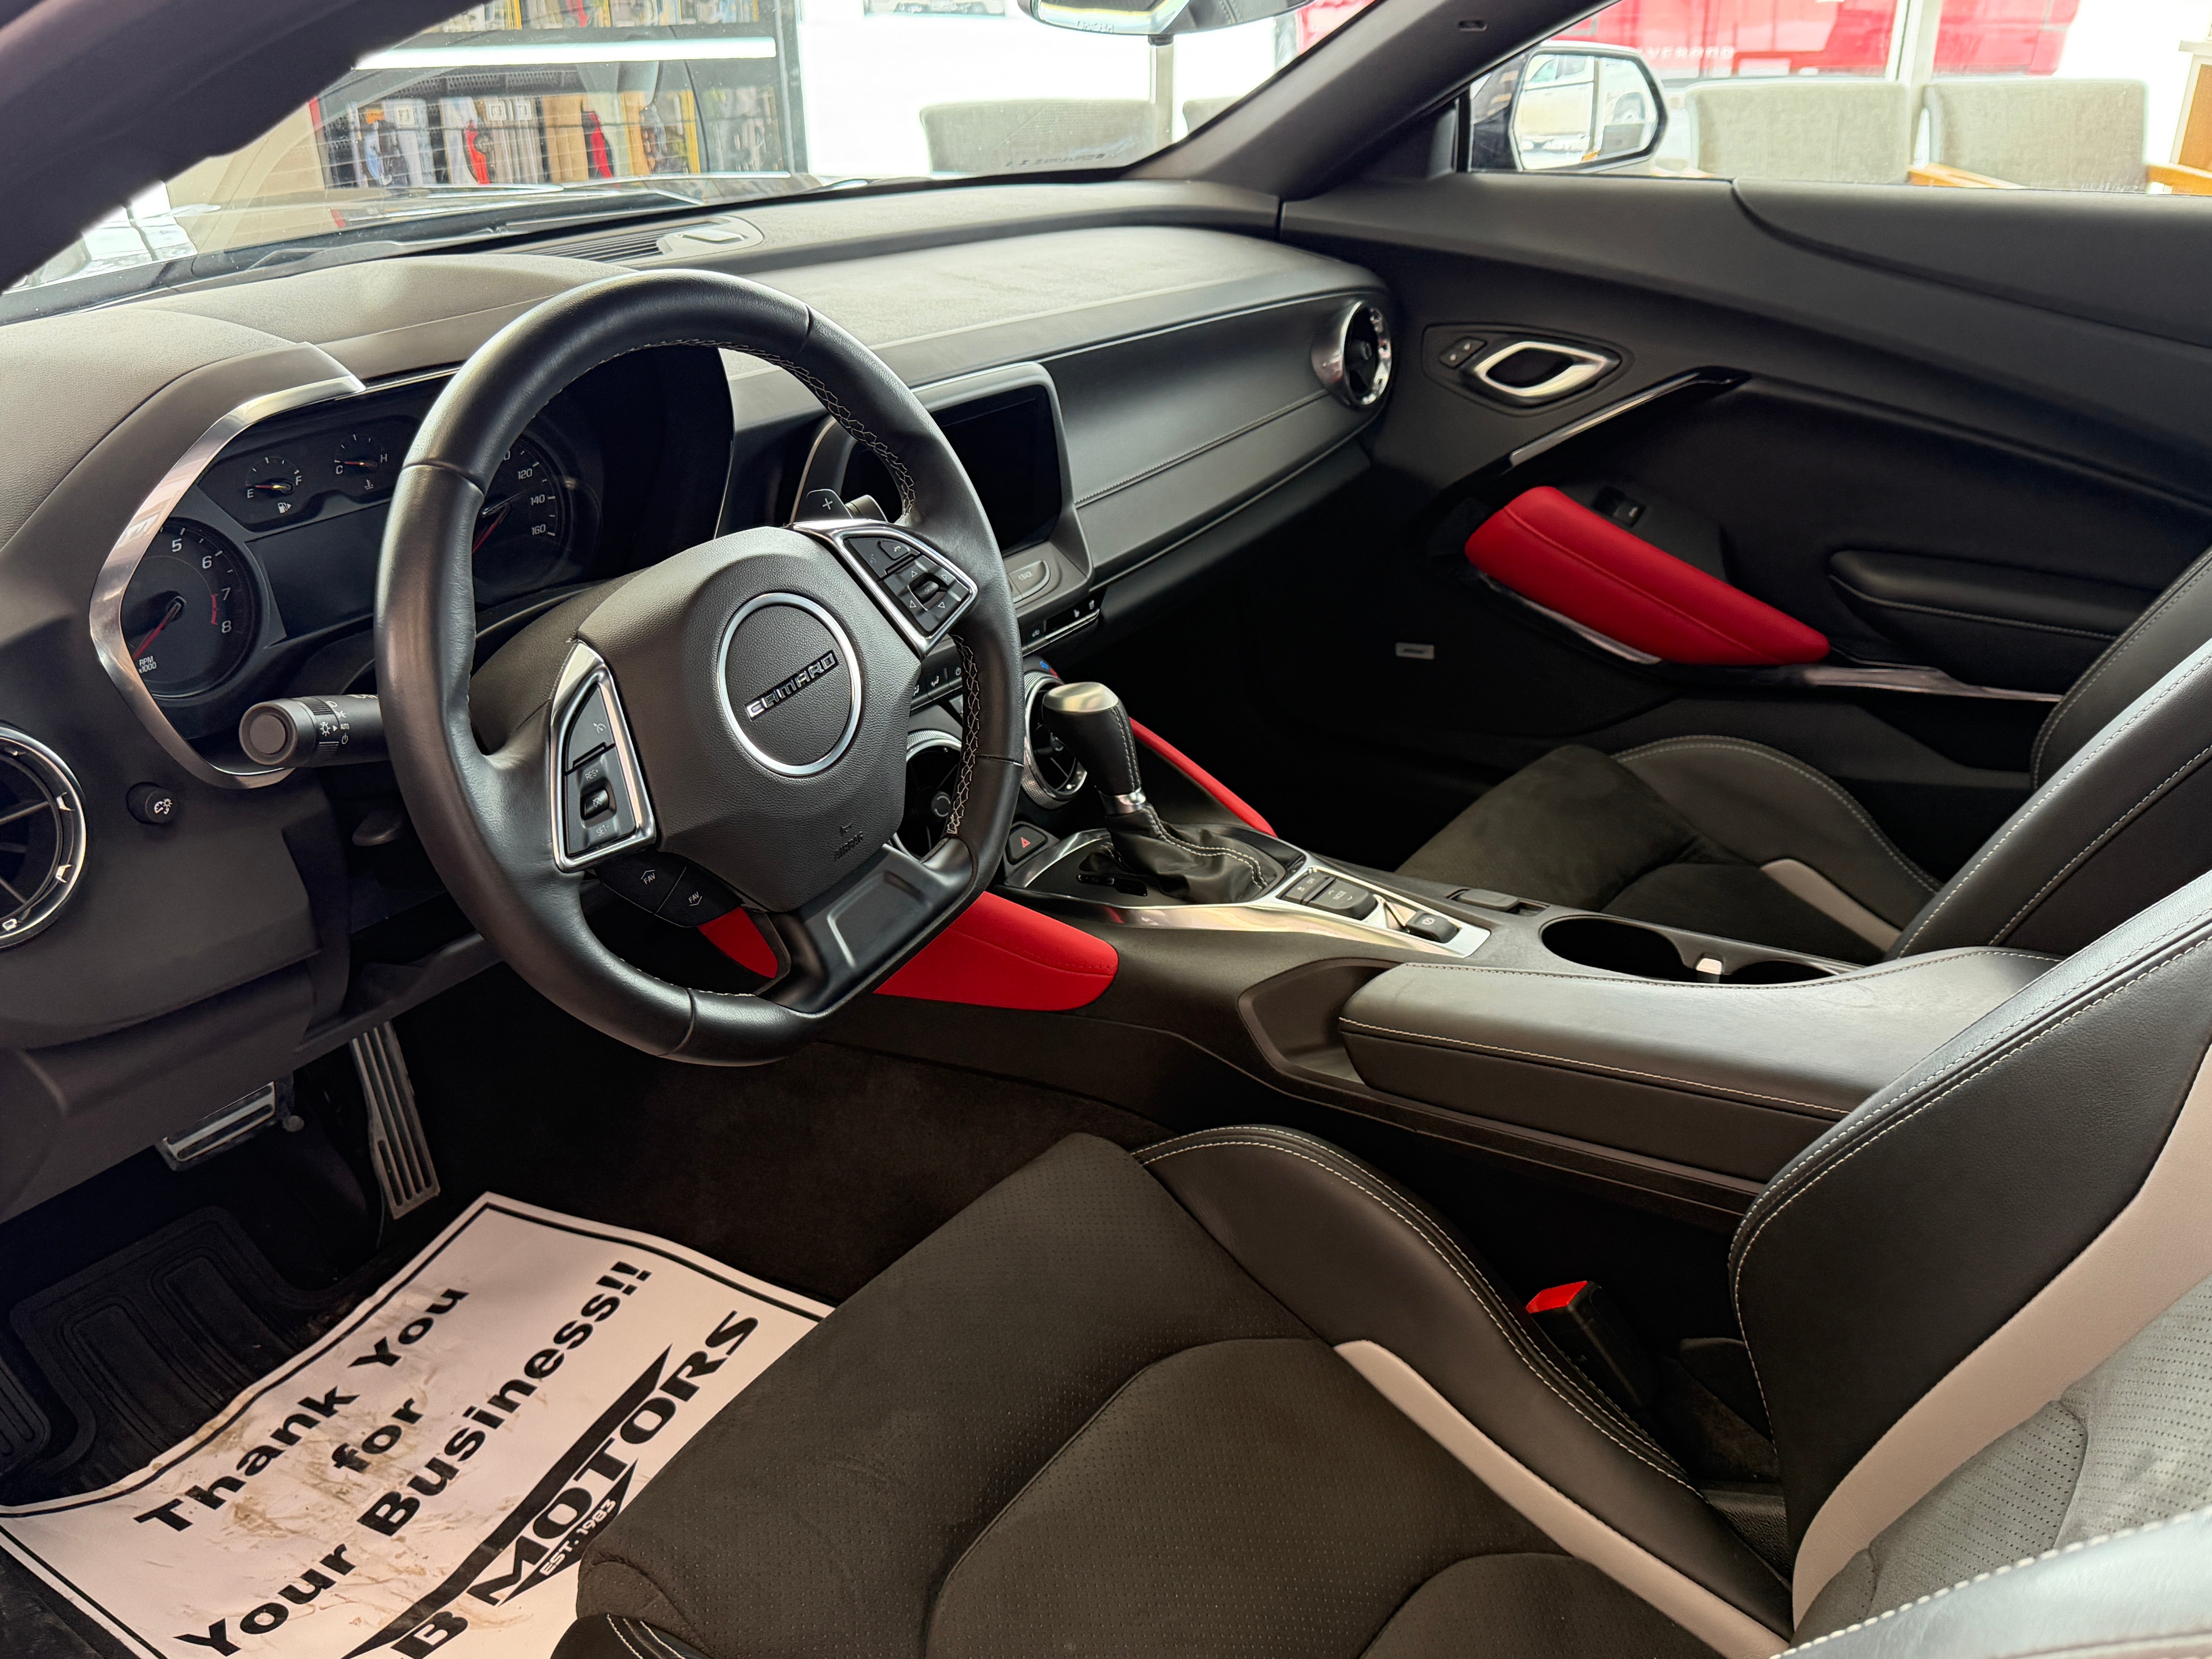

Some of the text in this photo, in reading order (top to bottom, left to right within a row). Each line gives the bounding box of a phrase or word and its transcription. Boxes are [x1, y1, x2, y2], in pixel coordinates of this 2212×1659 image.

[380, 453, 387, 463] H
[336, 465, 343, 474] C
[517, 468, 532, 479] 120
[295, 476, 302, 486] F
[247, 489, 254, 498] E
[531, 495, 545, 505] 140
[532, 524, 546, 535] 160
[172, 538, 182, 552] 5
[202, 556, 212, 569] 6
[221, 587, 230, 600] 7
[222, 620, 232, 633] 8
[139, 656, 153, 667] RPM
[746, 653, 836, 717] CAMARO
[643, 872, 656, 884] FAV
[688, 891, 699, 903] FAV
[133, 1288, 469, 1532] Thank You
[332, 1398, 423, 1473] for
[170, 1261, 652, 1657] Your Business!!
[390, 1310, 758, 1659] B MOTORS
[575, 1498, 616, 1535] 1983
